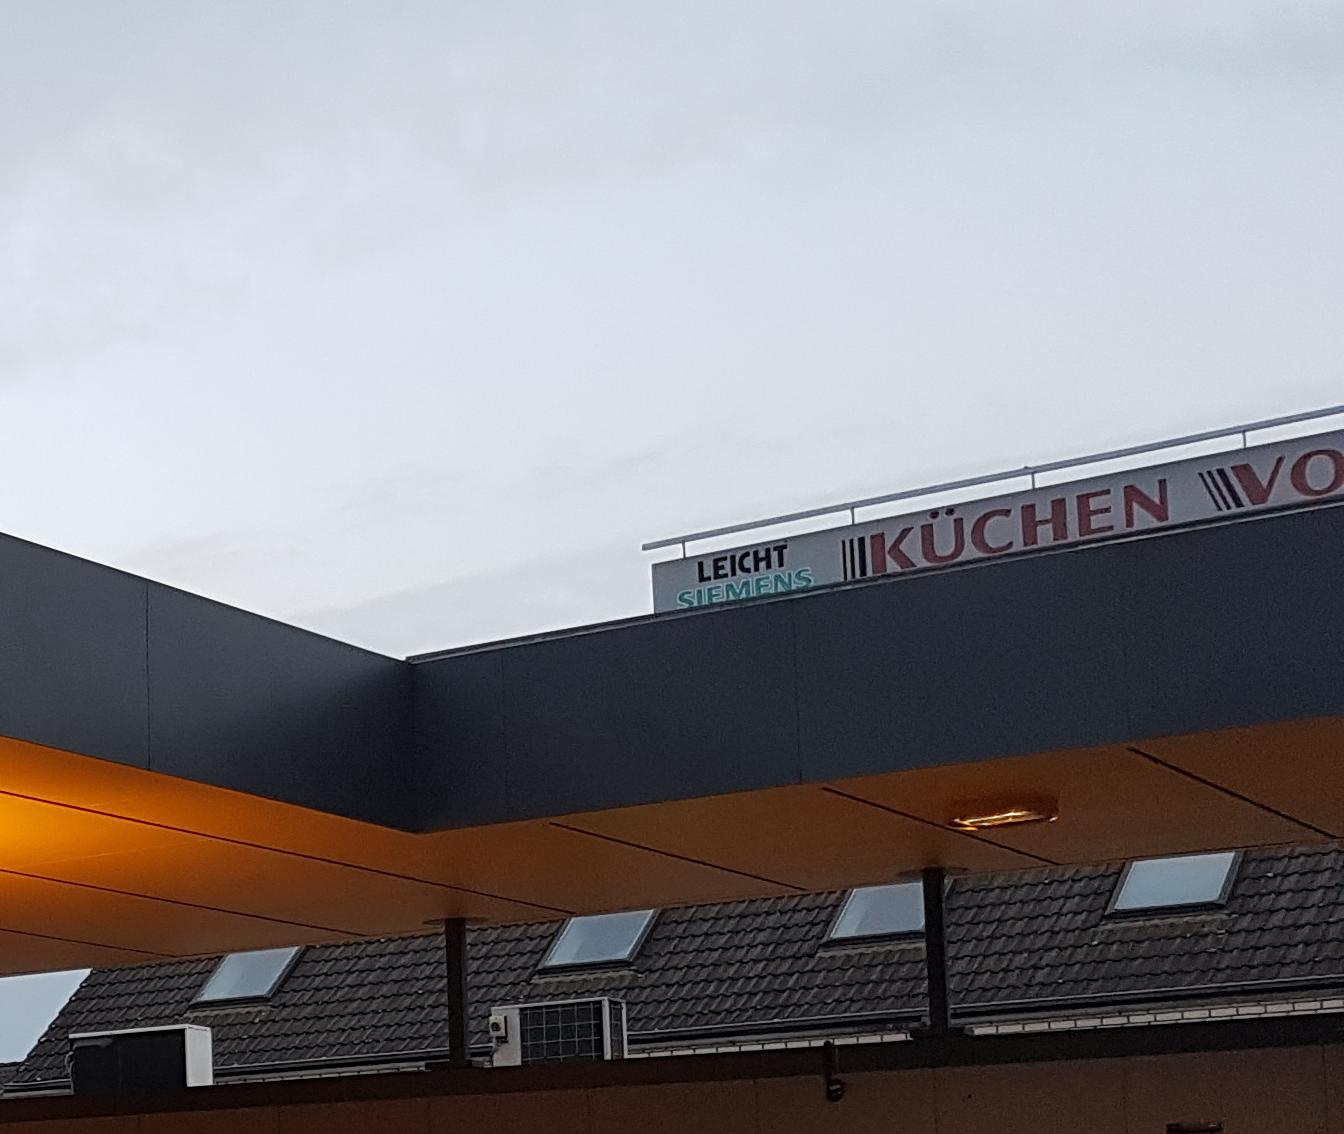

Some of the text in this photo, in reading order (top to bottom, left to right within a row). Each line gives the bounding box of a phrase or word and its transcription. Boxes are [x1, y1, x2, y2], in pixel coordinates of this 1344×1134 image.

[870, 479, 1170, 575] KÜCHEN
[697, 544, 788, 583] LEICHT
[676, 567, 815, 608] SIEMENS
